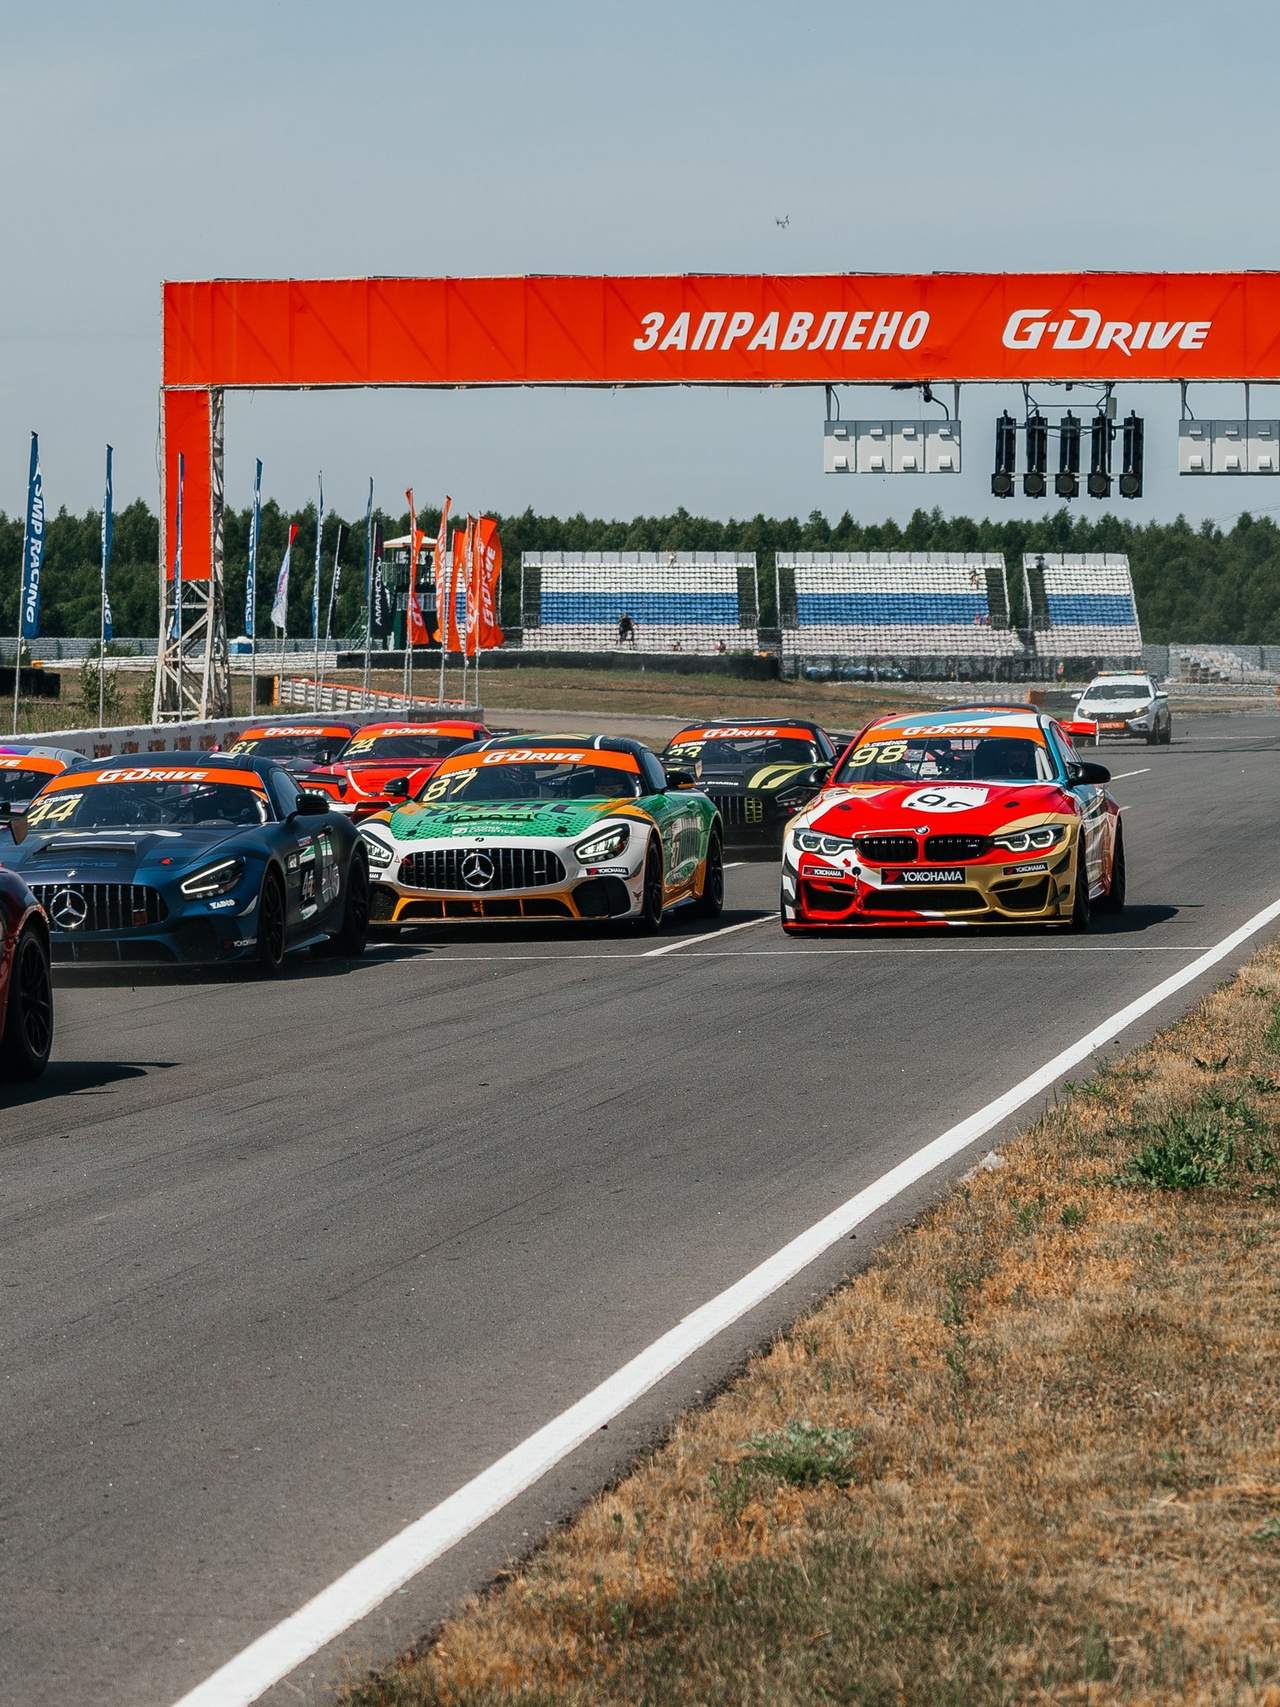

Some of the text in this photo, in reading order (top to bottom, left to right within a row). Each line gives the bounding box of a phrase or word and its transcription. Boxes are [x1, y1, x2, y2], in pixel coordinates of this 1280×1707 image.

[634, 311, 930, 353] ЗАПРАВЛЕНО
[25, 483, 43, 624] SMP RACING
[848, 745, 909, 767] 98
[422, 771, 478, 802] 87
[27, 799, 81, 826] 44
[813, 868, 842, 877] YOKOHAMA
[902, 871, 963, 882] YOKOHAMA
[1015, 865, 1045, 874] YOKOHAMA
